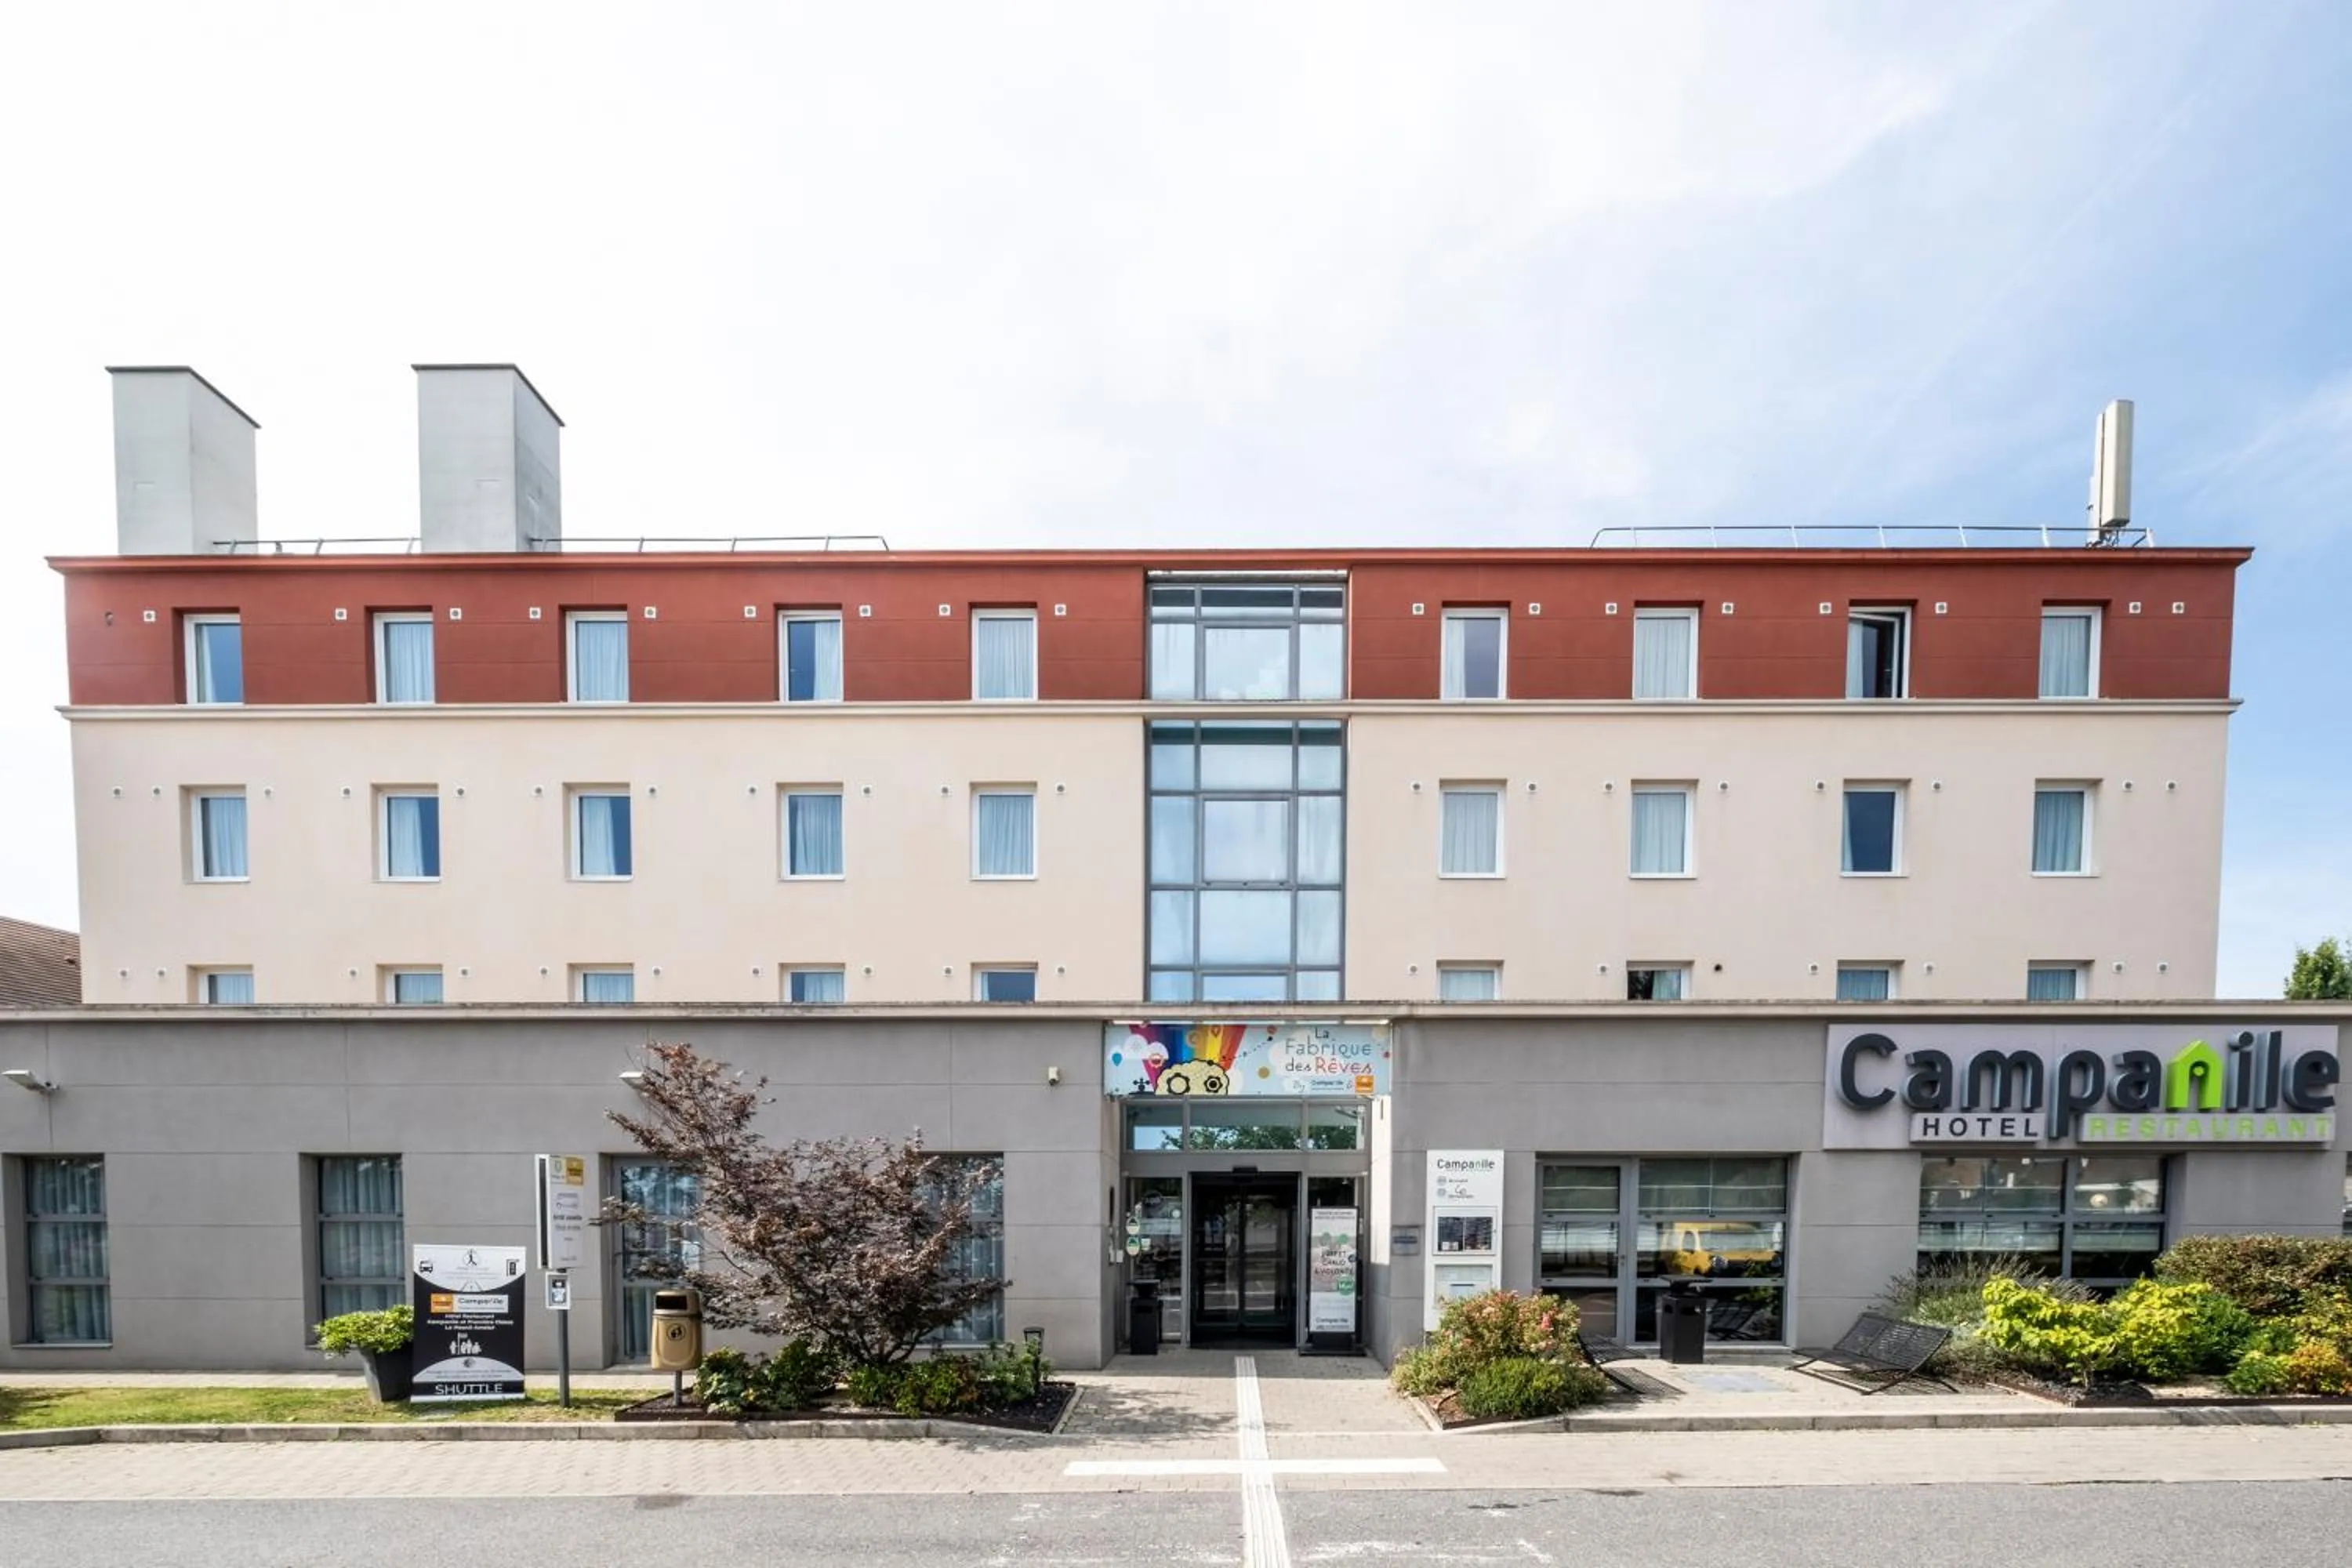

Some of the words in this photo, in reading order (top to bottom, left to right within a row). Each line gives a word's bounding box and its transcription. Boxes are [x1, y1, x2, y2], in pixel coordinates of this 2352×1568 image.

[1315, 1027, 1330, 1039] La
[1285, 1035, 1372, 1058] Fabrique
[1286, 1057, 1312, 1072] des
[1314, 1056, 1372, 1073] Rêves
[1837, 1029, 2340, 1139] Campanile
[1922, 1117, 2039, 1137] HOTEL
[2089, 1117, 2332, 1140] RESTAURANT
[1437, 1159, 1495, 1171] Campanile
[435, 1384, 503, 1395] SHUTTLE
